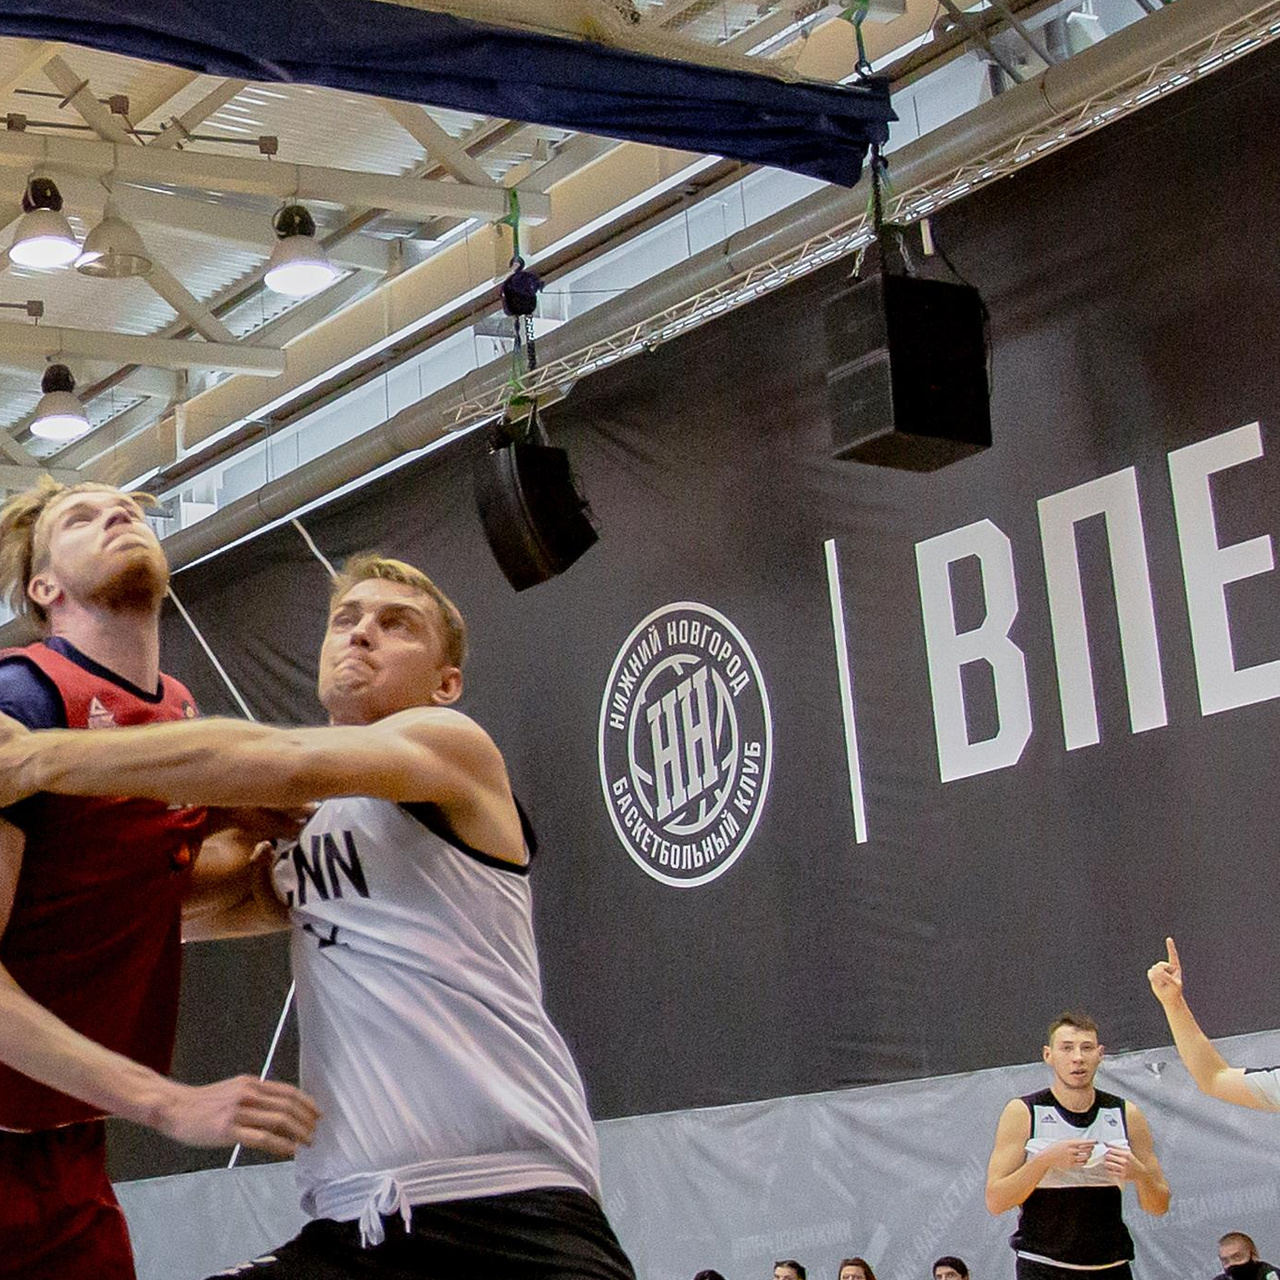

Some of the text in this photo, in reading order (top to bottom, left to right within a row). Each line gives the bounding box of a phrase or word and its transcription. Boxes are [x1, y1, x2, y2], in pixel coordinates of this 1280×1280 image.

[915, 421, 1280, 783] ВПЕ
[609, 619, 750, 730] НИЖНИЙ НОВГОРОД
[612, 741, 761, 870] БАСКЕТБОЛЬНЫЙ КЛУБ
[280, 830, 371, 907] NN
